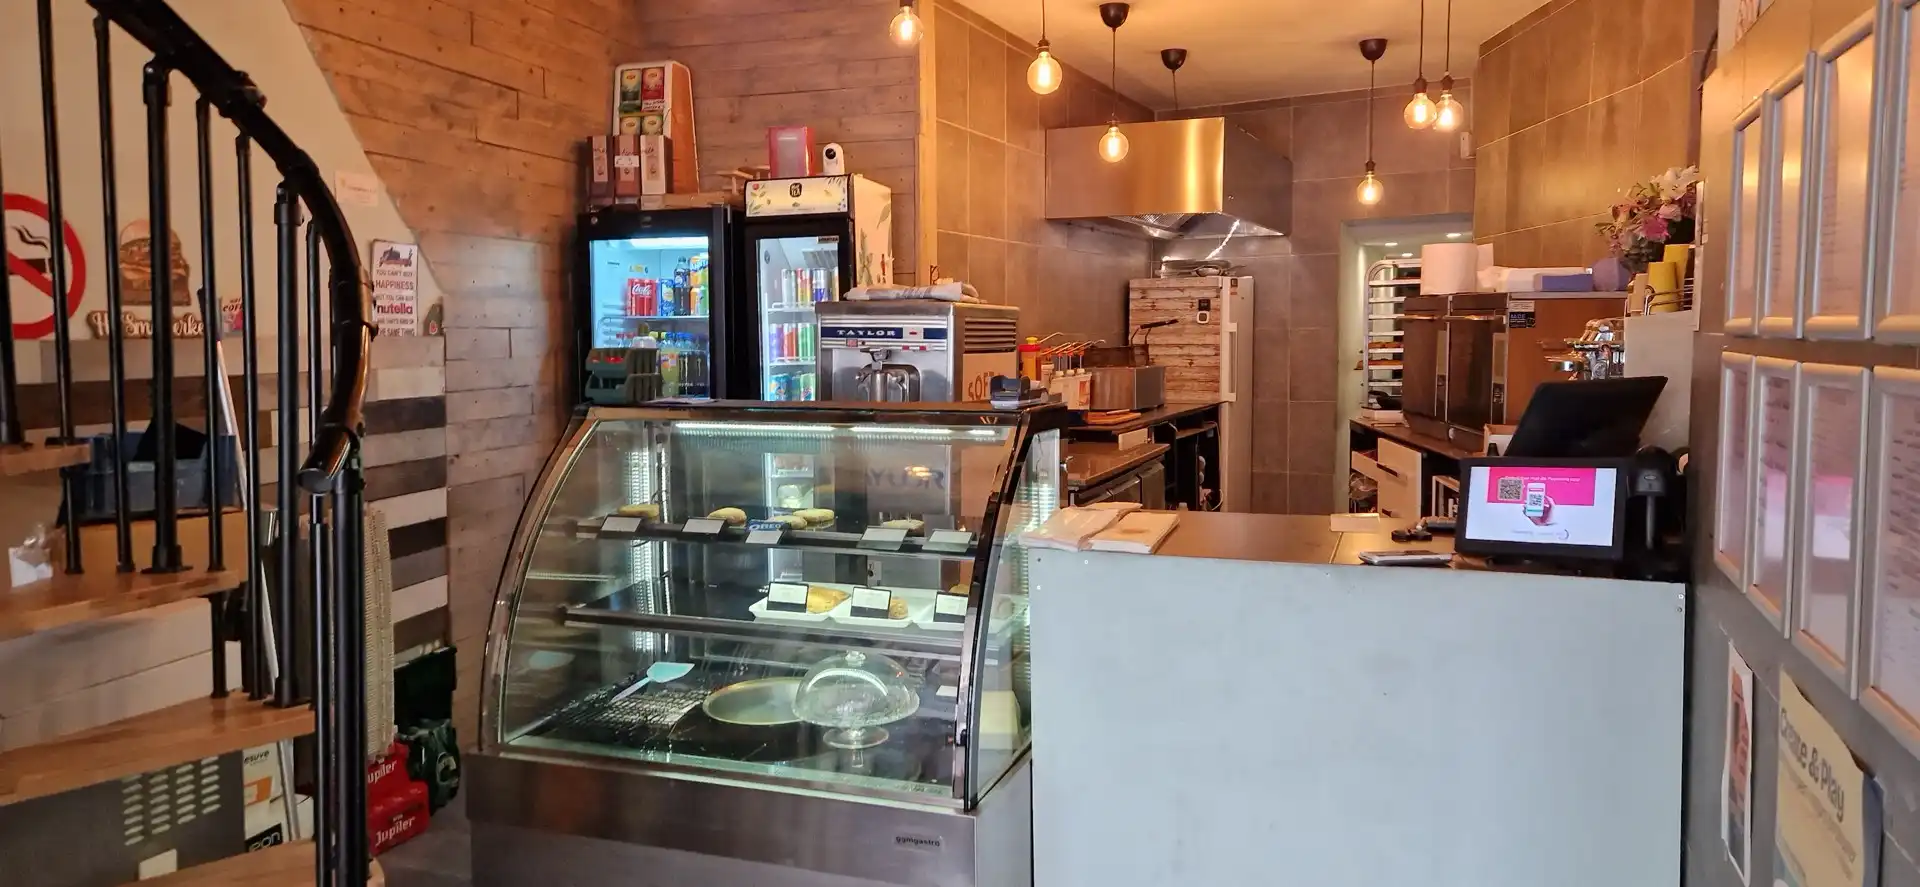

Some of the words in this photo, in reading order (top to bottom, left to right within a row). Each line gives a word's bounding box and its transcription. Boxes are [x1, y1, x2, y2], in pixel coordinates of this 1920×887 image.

[375, 280, 414, 290] HAPPINESS
[377, 303, 413, 314] nutella
[749, 523, 781, 531] OREO
[367, 760, 397, 784] upiler
[1808, 747, 1820, 782] &
[1820, 756, 1845, 823] Play
[375, 816, 416, 848] Jupiler
